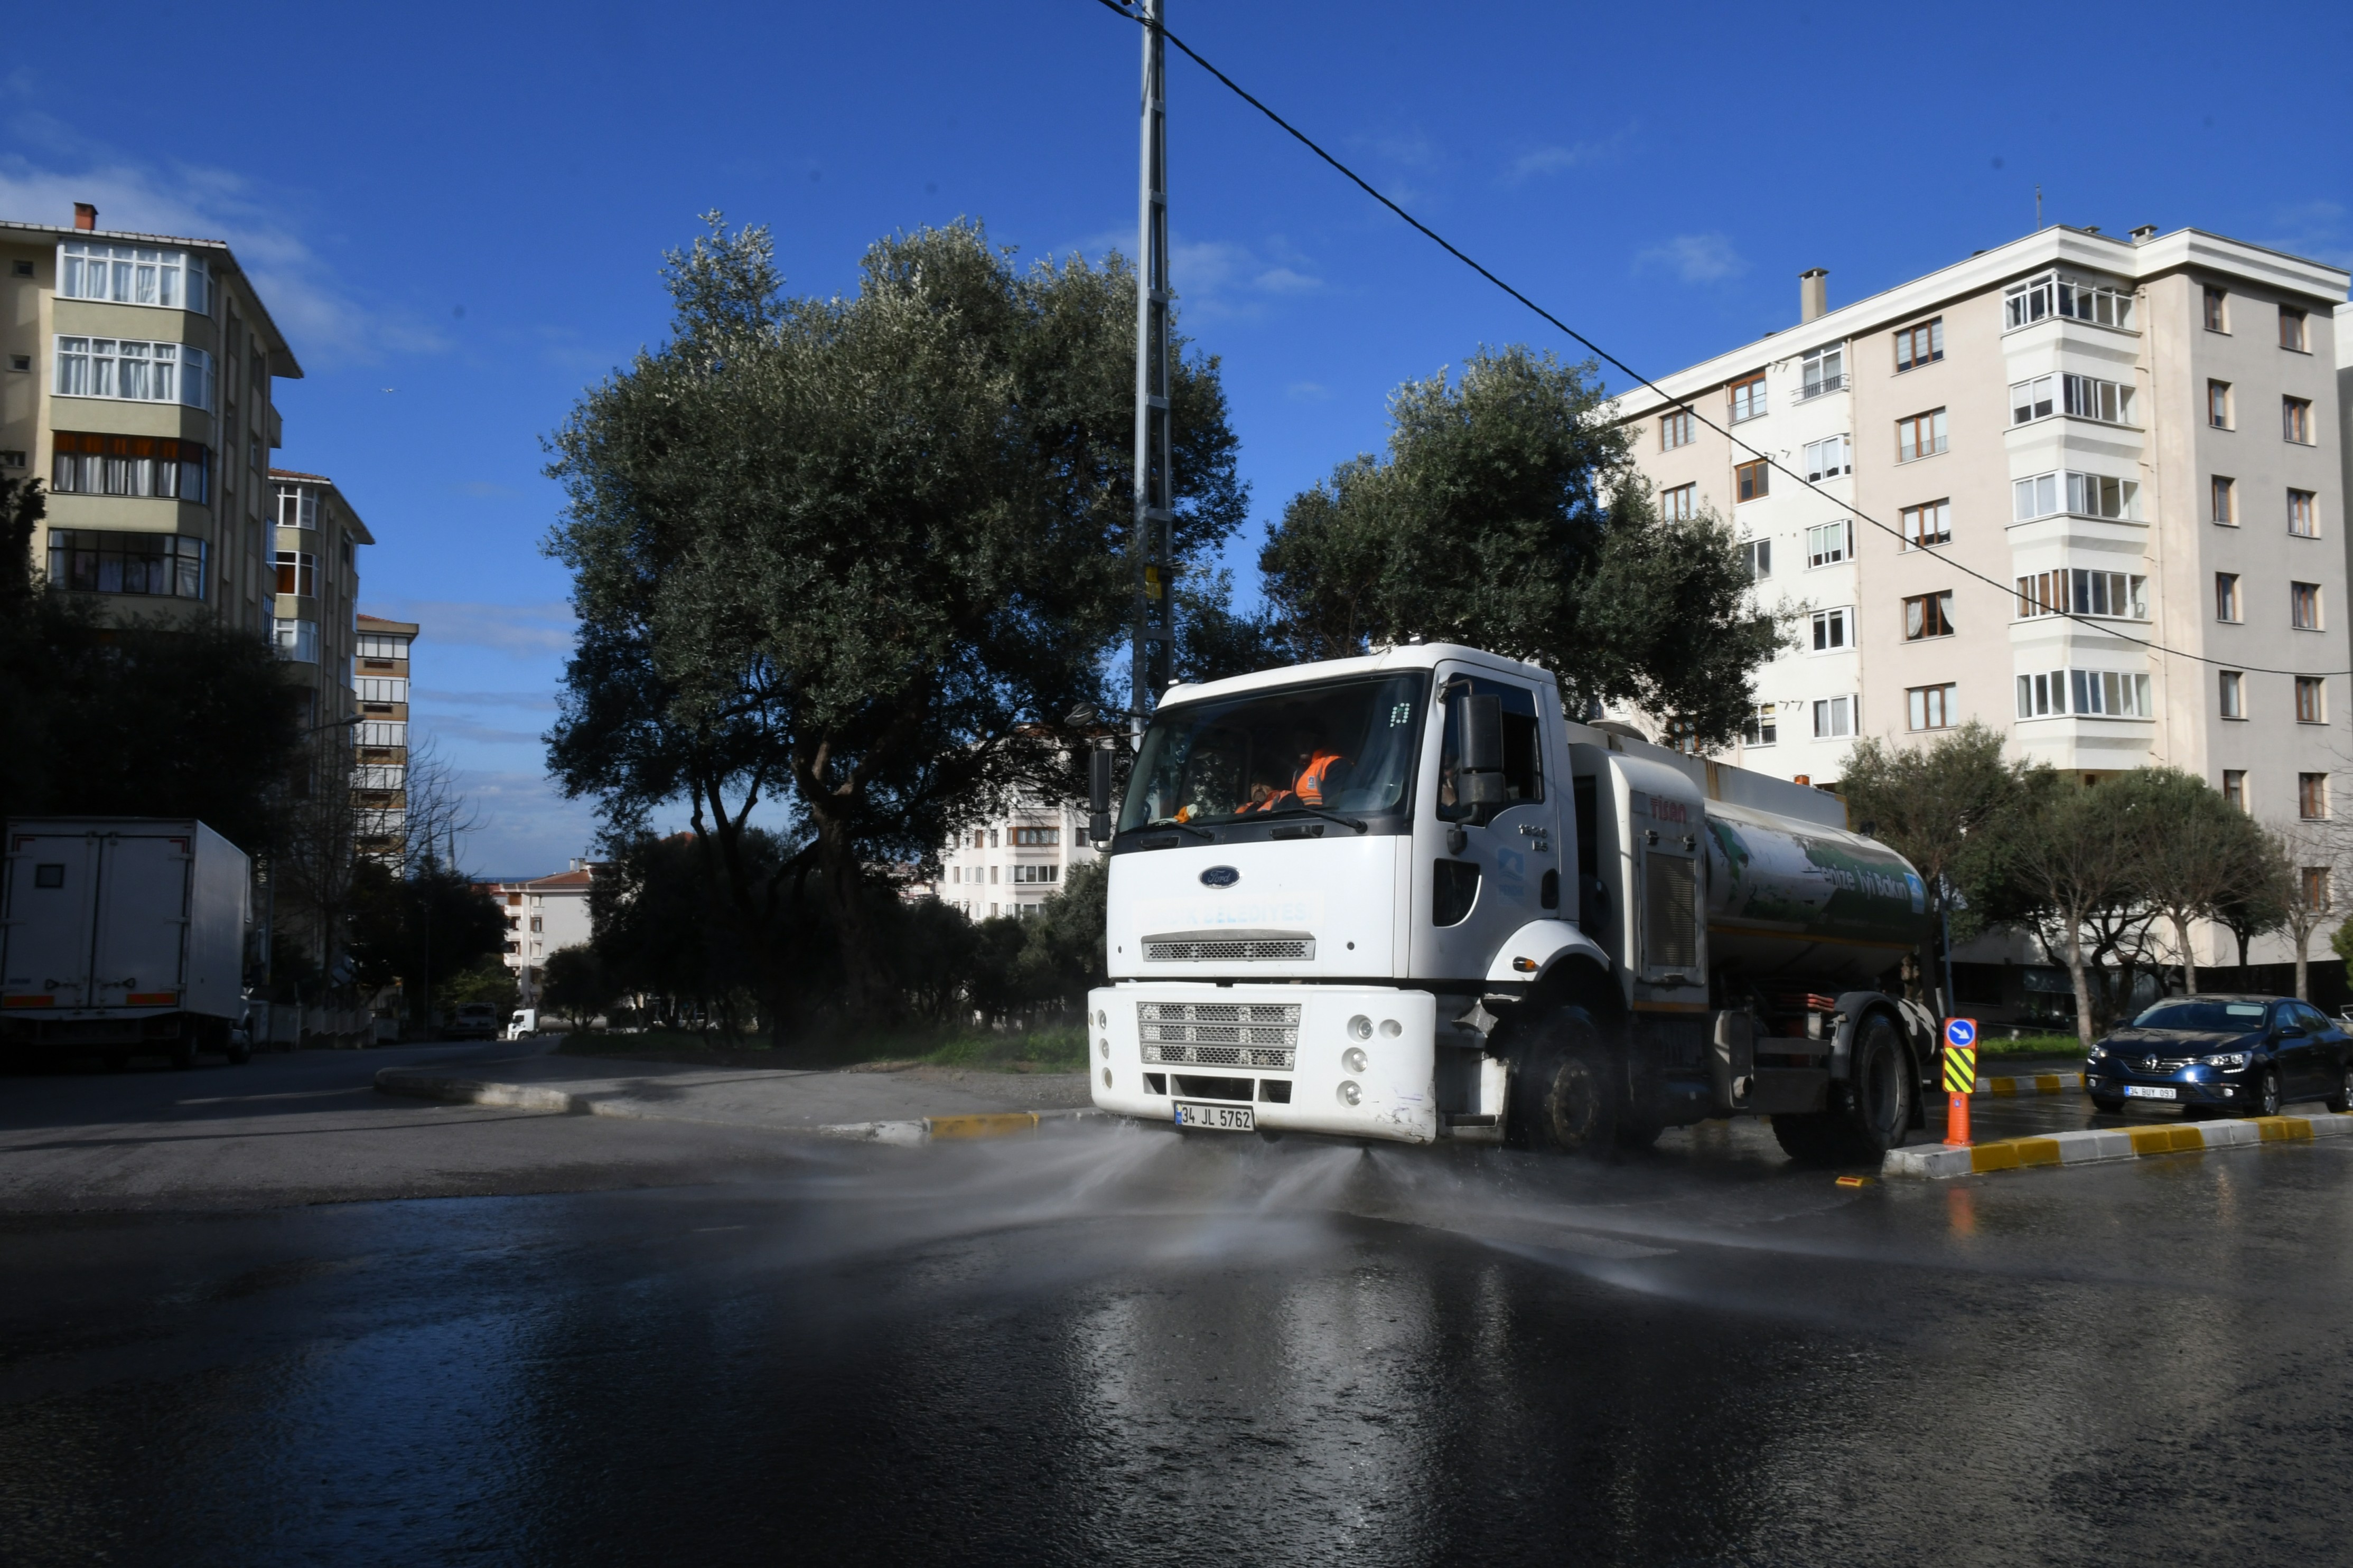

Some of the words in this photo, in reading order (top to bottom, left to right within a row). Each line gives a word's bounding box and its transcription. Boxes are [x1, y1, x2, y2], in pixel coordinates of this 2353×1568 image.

[1532, 840, 1548, 852] E5
[1208, 870, 1231, 883] Ford
[1817, 863, 1856, 891] enize
[2160, 1089, 2174, 1097] 093
[1182, 1107, 1195, 1123] 34
[1201, 1109, 1215, 1125] JL
[1220, 1110, 1250, 1128] 5762
